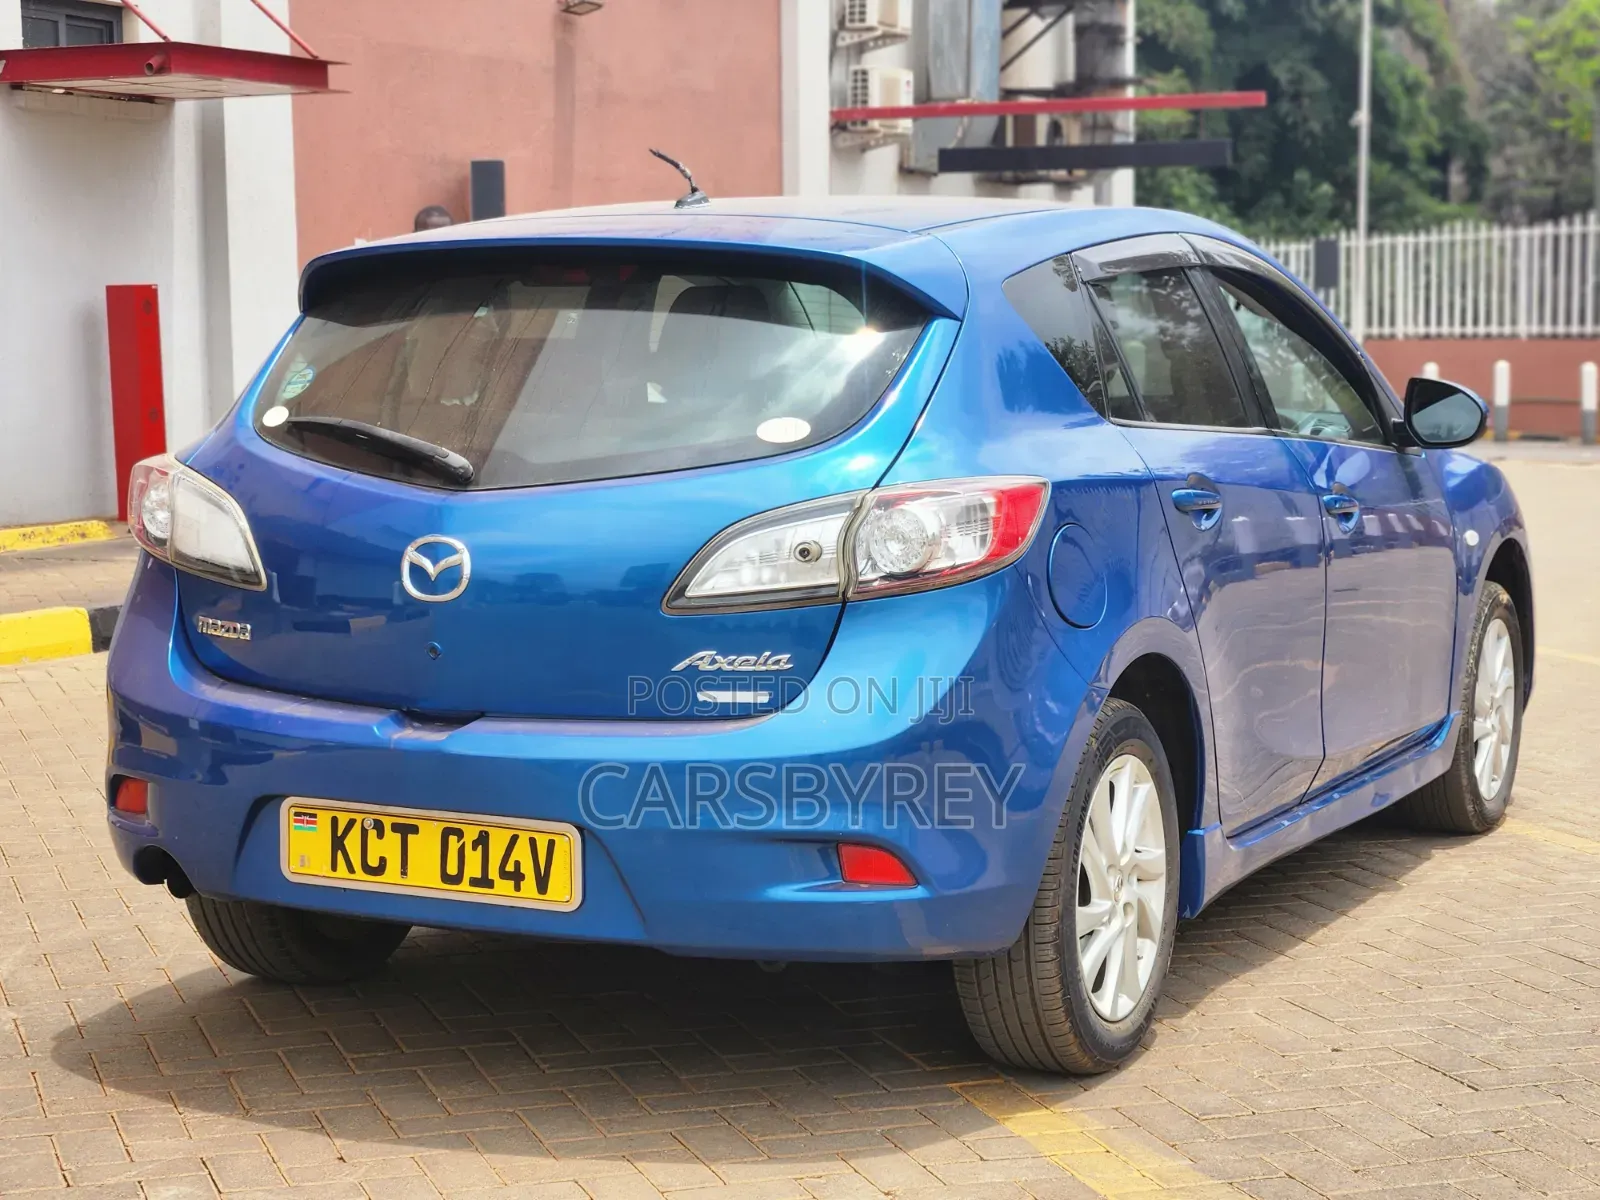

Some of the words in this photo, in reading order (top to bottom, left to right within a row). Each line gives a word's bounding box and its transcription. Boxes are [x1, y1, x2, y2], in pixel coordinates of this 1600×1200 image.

[671, 650, 794, 671] Axela
[330, 815, 419, 879] KCT
[440, 826, 556, 896] 014V
[1070, 790, 1091, 876] TOURING
